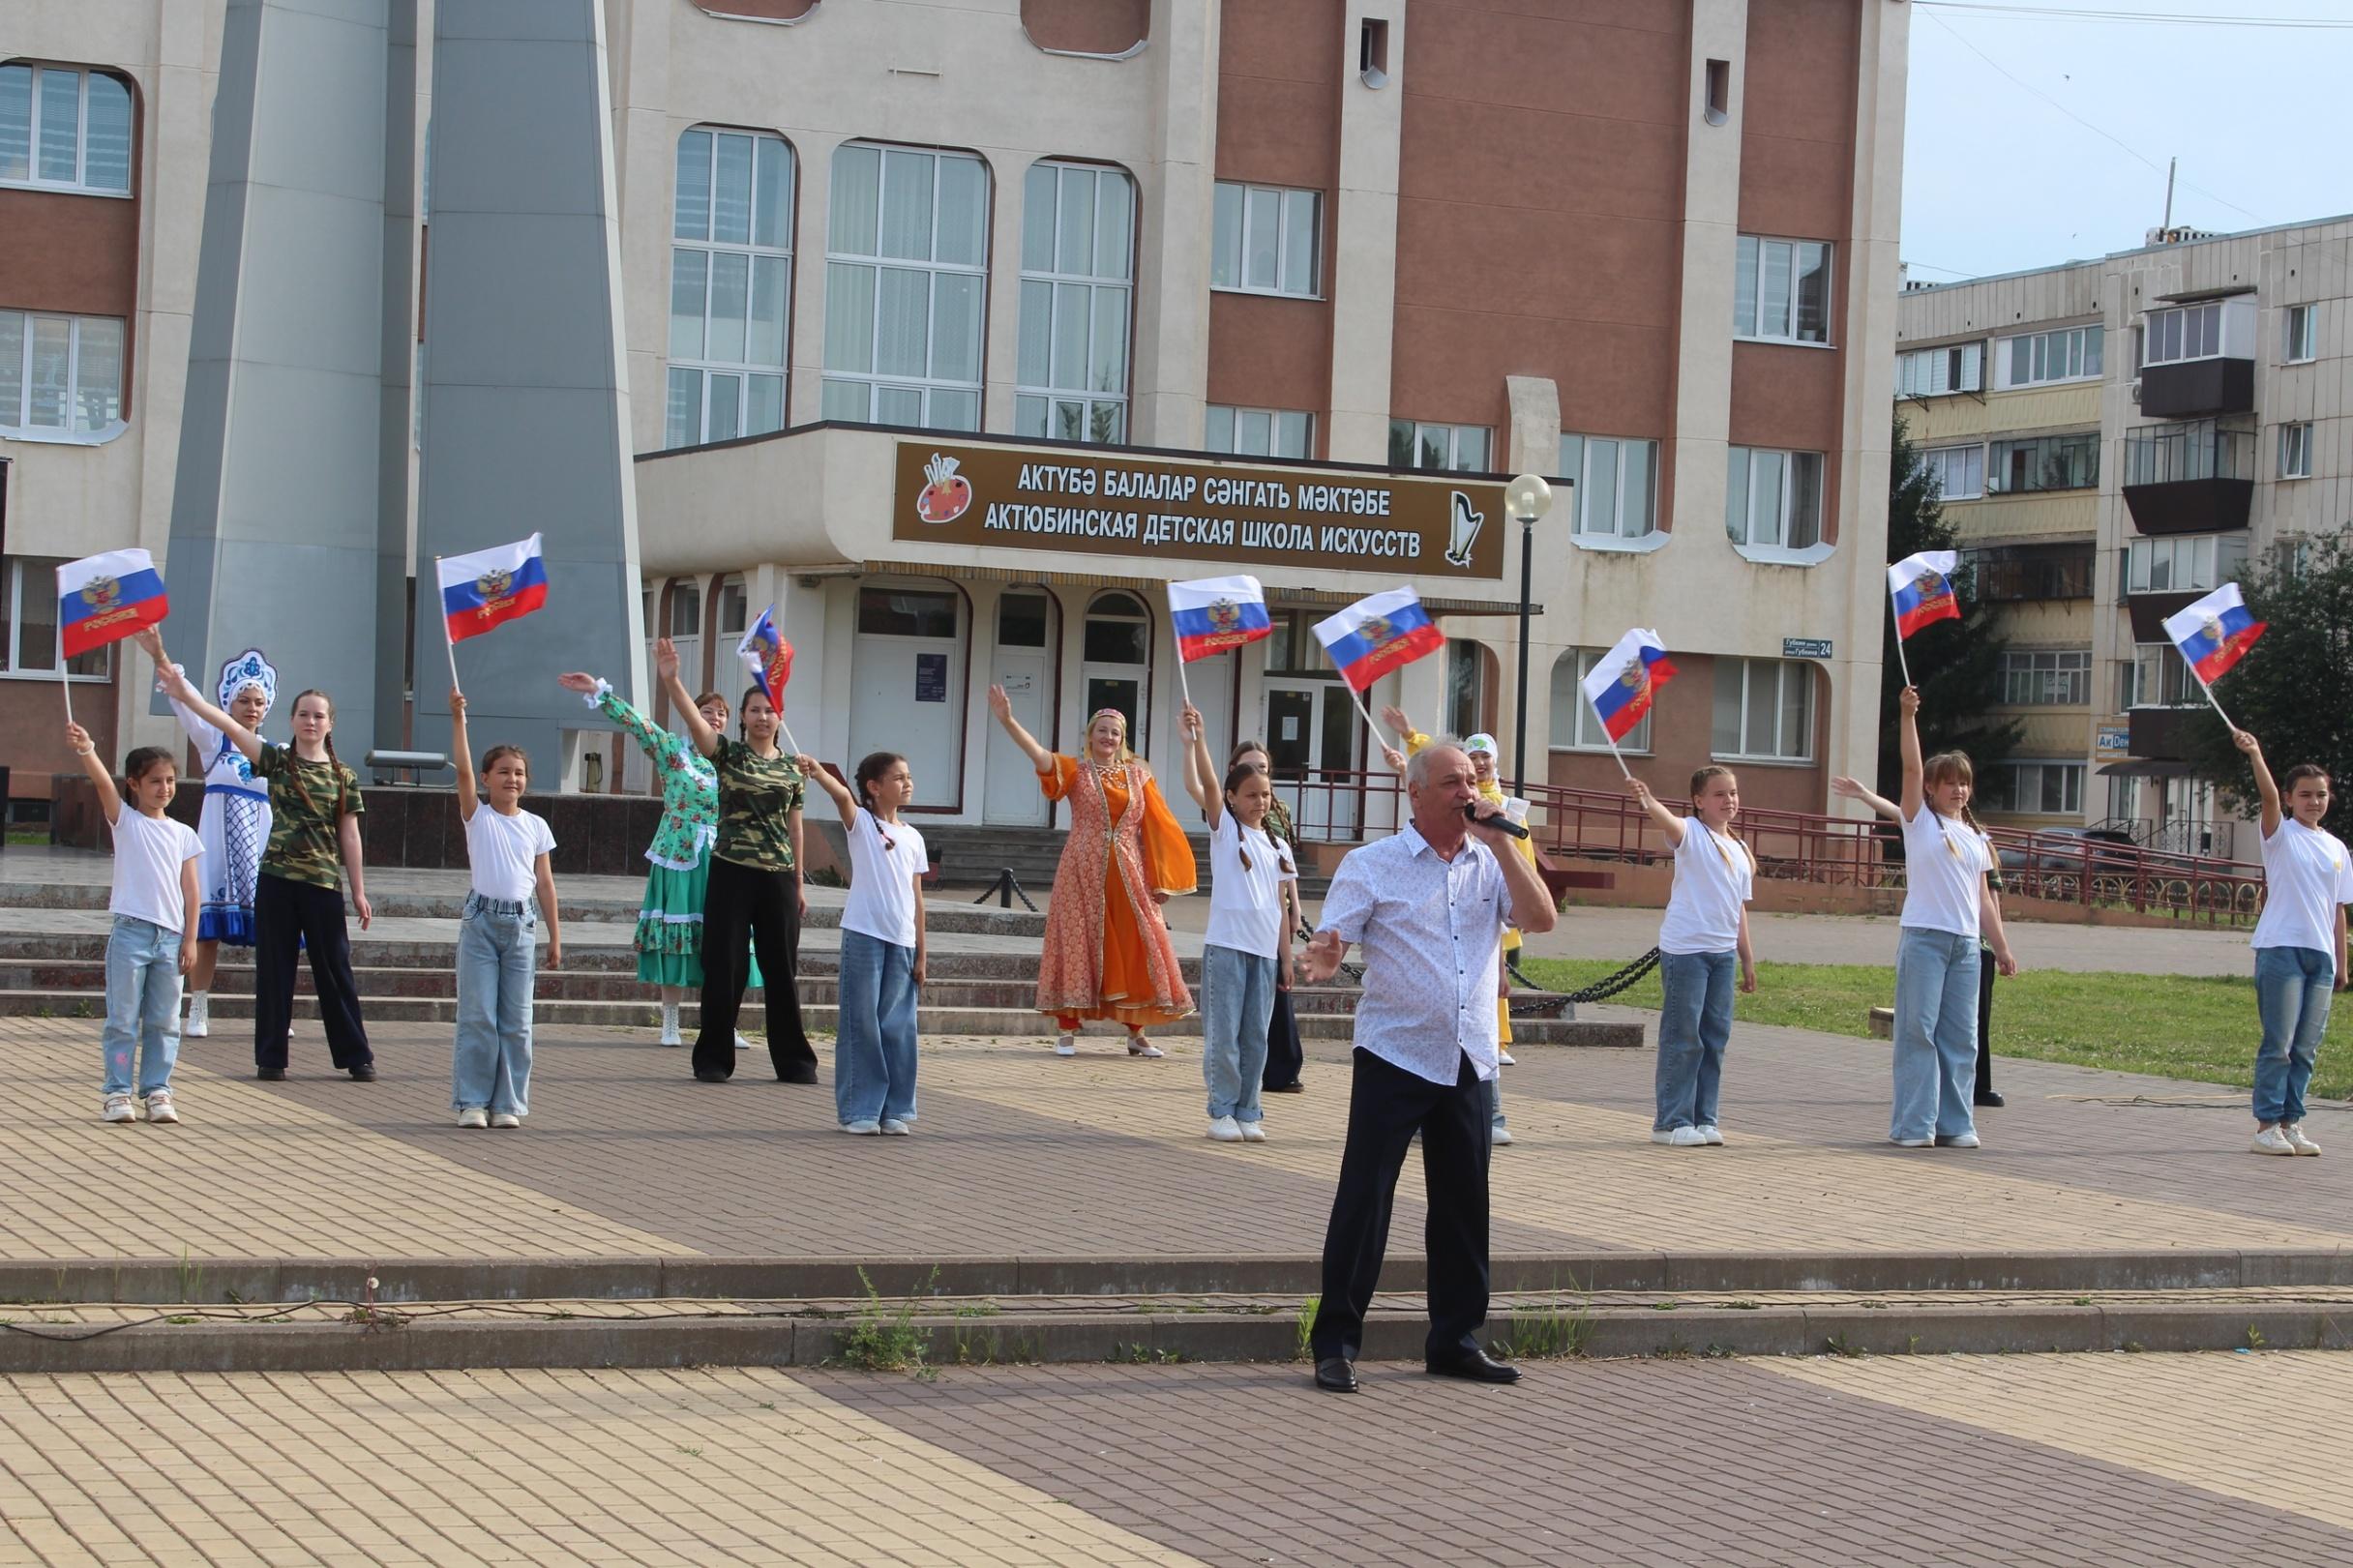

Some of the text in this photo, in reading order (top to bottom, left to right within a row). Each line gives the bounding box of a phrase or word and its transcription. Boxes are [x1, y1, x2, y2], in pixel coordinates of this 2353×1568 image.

[1104, 469, 1197, 502] БАЛАЛАР
[1203, 477, 1291, 510] СӘНГАТЬ
[1297, 485, 1390, 516] МӘКТӘБЕ
[984, 503, 1421, 558] АКТЮБИНСКАЯ ДЕТСКАЯ ШКОЛА ИСКУССТВ
[83, 607, 139, 633] РОССИЯ
[1820, 642, 1832, 656] 24
